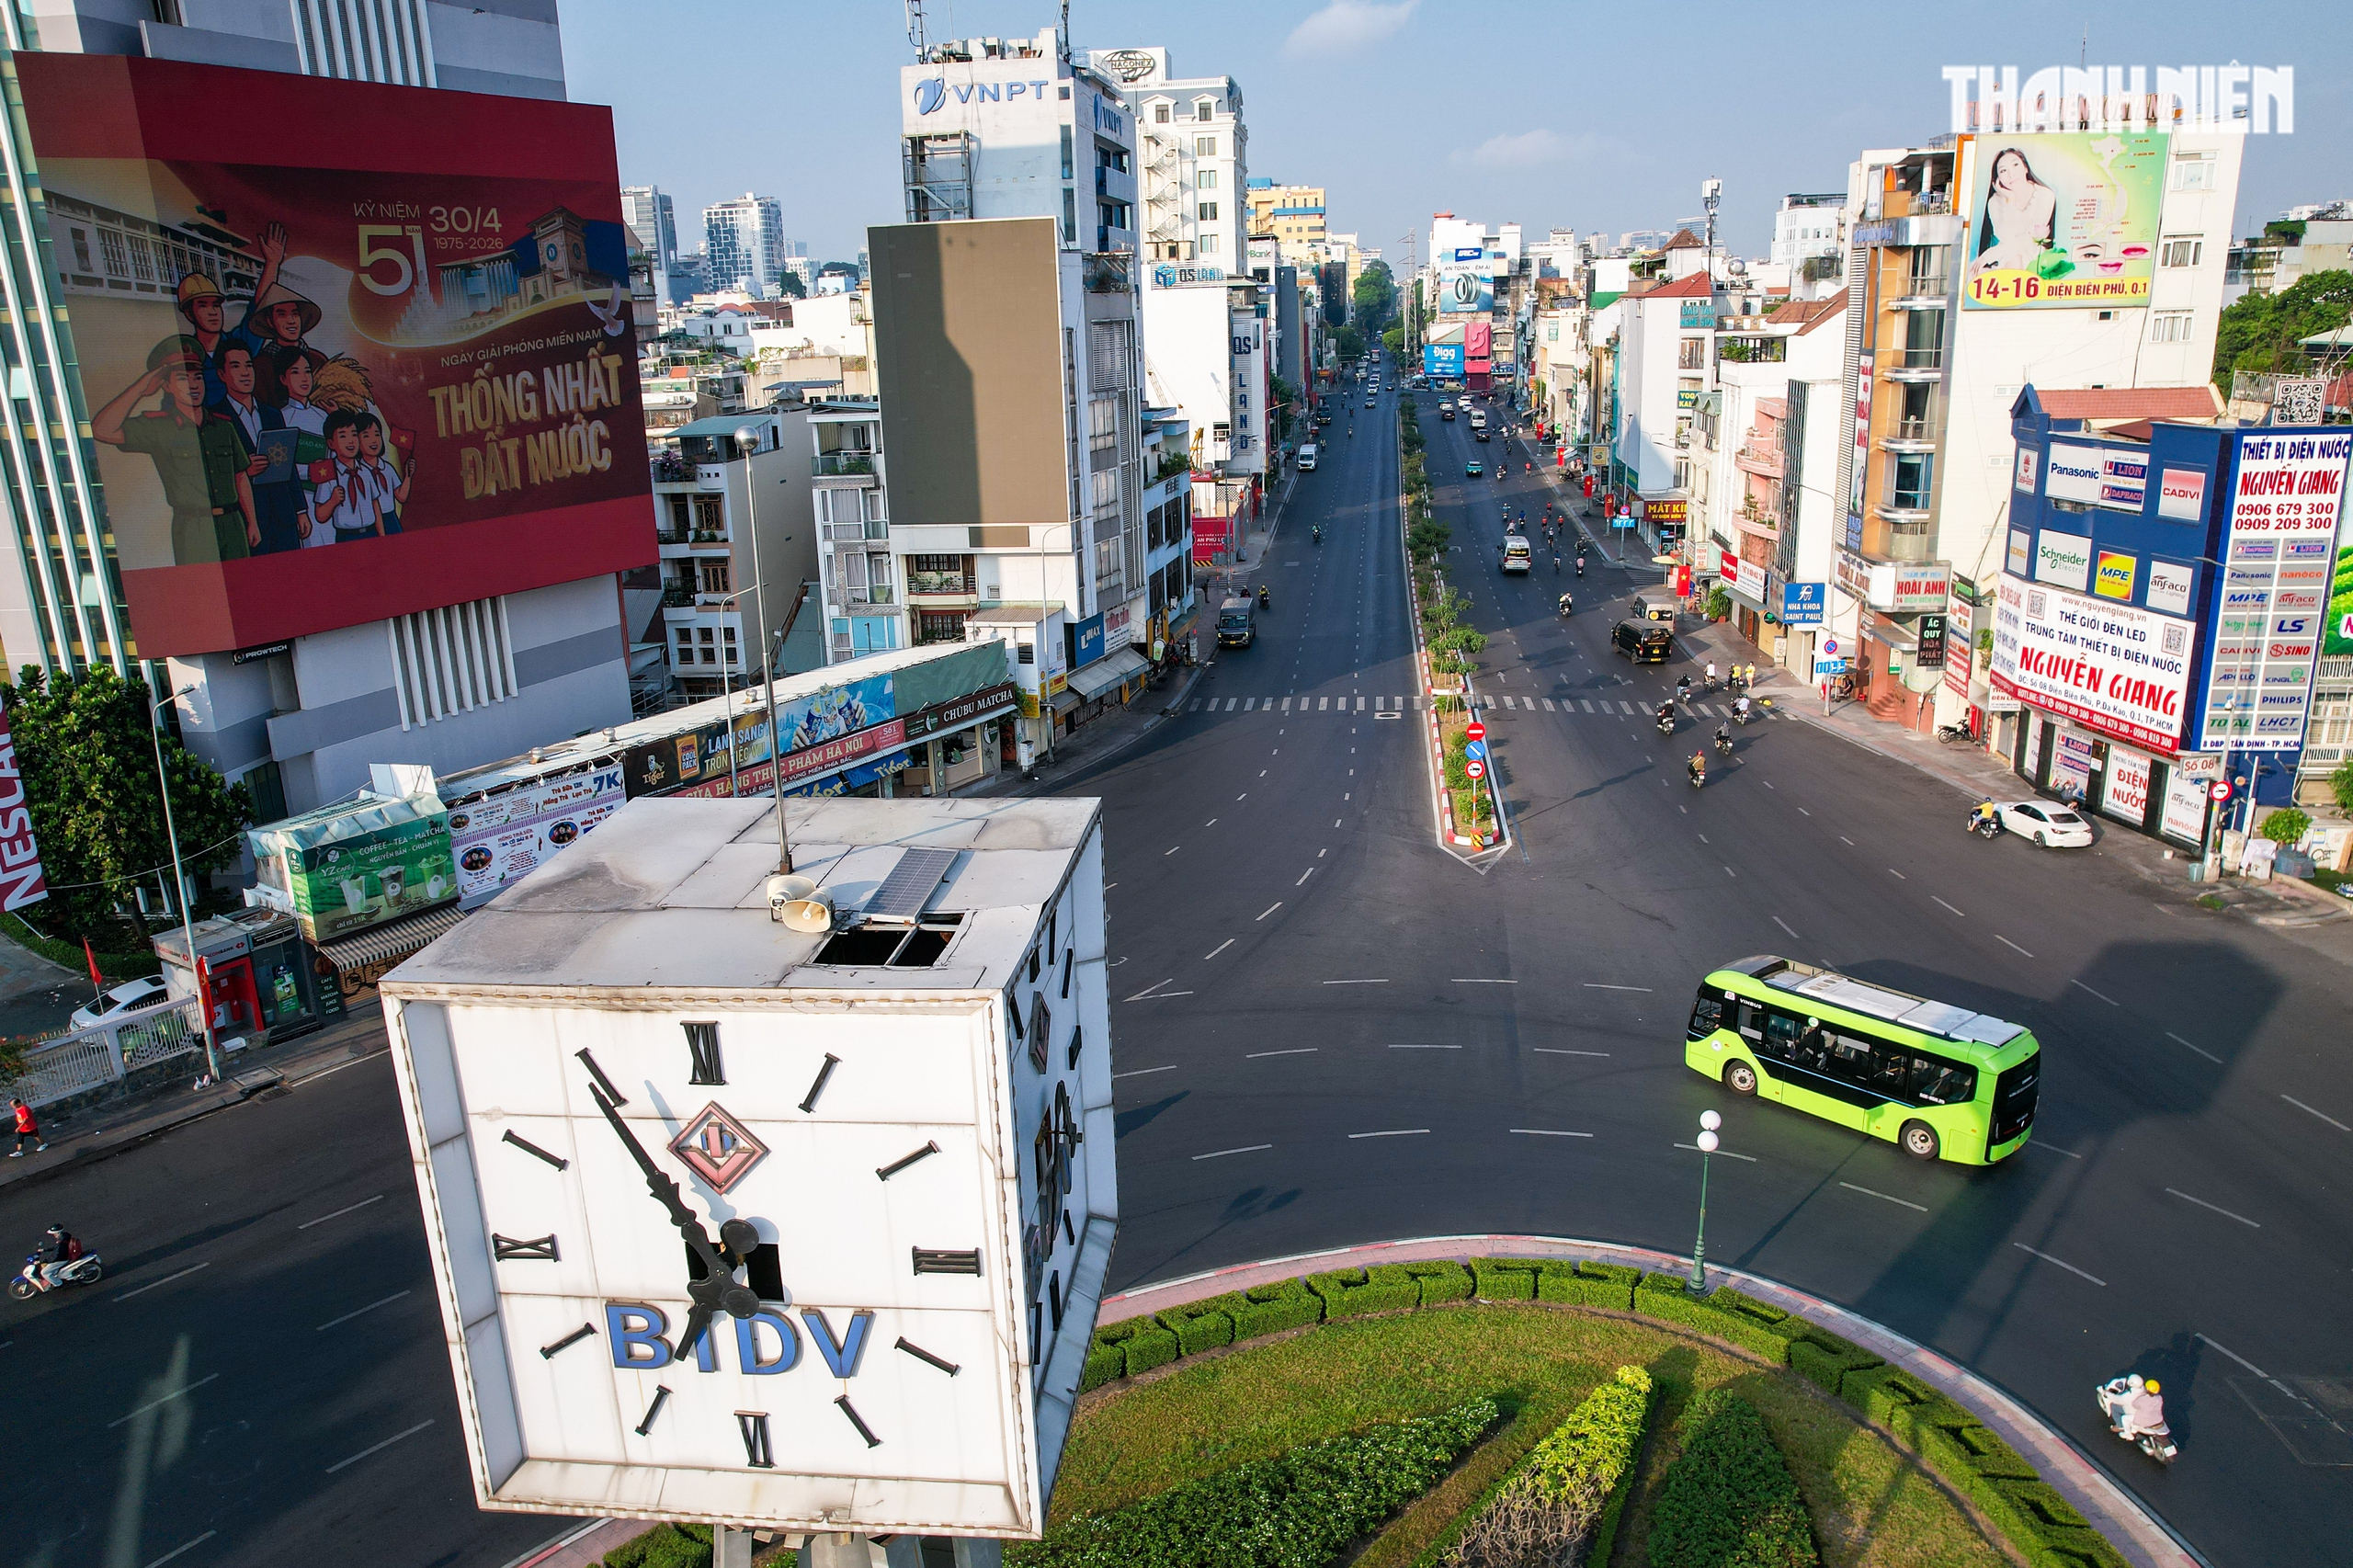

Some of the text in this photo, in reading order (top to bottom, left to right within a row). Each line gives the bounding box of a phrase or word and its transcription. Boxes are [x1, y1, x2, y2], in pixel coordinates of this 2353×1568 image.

[951, 80, 1049, 104] VNPT
[1102, 105, 1123, 137] VNPT
[380, 200, 421, 221] NIỆM
[429, 206, 503, 233] 30/4
[434, 237, 504, 250] 1975-2026
[358, 224, 429, 296] 51
[1179, 267, 1223, 282] QS LAND
[1972, 275, 2149, 301] 14-16 ĐIỆN BIÊN PHỦ, Q.1
[440, 328, 602, 368] NGÀY GIẢI PHÓNG MIỀN NAM
[1233, 335, 1251, 355] QS
[427, 341, 623, 439] THỐNG NHẤT
[1238, 372, 1248, 449] LAND
[460, 413, 612, 500] ĐẤT NƯỚC
[2243, 436, 2350, 463] THIẾT BỊ ĐIỆN NƯỚC
[2051, 462, 2099, 480] Panasonic
[2117, 464, 2143, 477] LION
[2239, 463, 2341, 495] NGUYỄN GIANG
[2111, 489, 2143, 502] DAPHACO
[2163, 487, 2200, 500] CADIVI
[2236, 502, 2334, 516] 0906 679 300
[2234, 517, 2332, 530] 0909 209 300
[2040, 545, 2087, 567] Schneider
[2058, 562, 2085, 574] Electric
[2100, 566, 2131, 581] MPE
[2280, 570, 2323, 579] nanoco
[1896, 579, 1946, 595] HOÀI ANH
[2151, 576, 2187, 593] anfaco
[2228, 593, 2268, 602] MPE
[1805, 612, 1822, 620] PAUL
[2062, 596, 2147, 623] www.nguyengiang.vn
[2059, 609, 2146, 642] THẾ GIỚI ĐÈN LED
[2277, 619, 2305, 632] LS
[1923, 630, 1941, 639] QUY
[245, 644, 288, 659] PROWTECH
[2026, 622, 2182, 675] TRUNG TÂM THIẾT BỊ ĐIỆN NƯỚC
[2284, 645, 2311, 655] SINO
[2019, 646, 2104, 693] NGUYỄN
[2109, 674, 2178, 716] GIANG
[977, 689, 1013, 710] MATCHA
[2018, 675, 2173, 732] ĐC: Số 08 Điện Biên Kao, TP.HCM
[2261, 696, 2302, 704] PHILIPS
[2017, 687, 2039, 703] HOTLINE:
[2054, 701, 2068, 713] 0909
[2068, 705, 2078, 716] 209
[2078, 710, 2089, 720] 300
[2093, 712, 2107, 725] 0906
[2107, 718, 2118, 730] 679
[2118, 722, 2130, 733] 300
[2132, 726, 2147, 740] 0906
[2148, 732, 2160, 744] 819
[2160, 736, 2173, 748] 300
[2259, 717, 2300, 727] LHCT
[789, 750, 824, 773] PHẨM
[827, 744, 843, 759] HÀ
[846, 736, 864, 754] NỘI
[2068, 740, 2089, 754] LION
[681, 751, 697, 763] COOL
[704, 742, 766, 773] TRỌN VUI
[824, 761, 838, 769] PHÍA
[2185, 758, 2214, 771] Số 08
[681, 760, 697, 772] PACK
[874, 757, 910, 778] Tiger
[593, 770, 621, 792] 7K
[642, 768, 665, 785] Tiger
[2117, 768, 2147, 790] ĐIỆN
[562, 784, 573, 792] Sữa
[574, 781, 583, 790] 12K
[542, 795, 559, 806] Hồng
[559, 794, 569, 802] Trà
[583, 787, 592, 796] Trà
[2167, 816, 2201, 835] nanoco
[359, 825, 446, 856] COFFEE TEA MATCHA
[369, 851, 394, 864] NGUYÊN
[321, 866, 336, 877] YZ
[336, 915, 367, 928] chỉ từ 19K
[320, 991, 338, 1000] MATCHA
[1739, 997, 1763, 1009] VINBUS
[325, 1006, 339, 1015] FOOD
[680, 1020, 725, 1086] XII
[912, 1244, 982, 1278] III
[605, 1299, 876, 1381] BIDV
